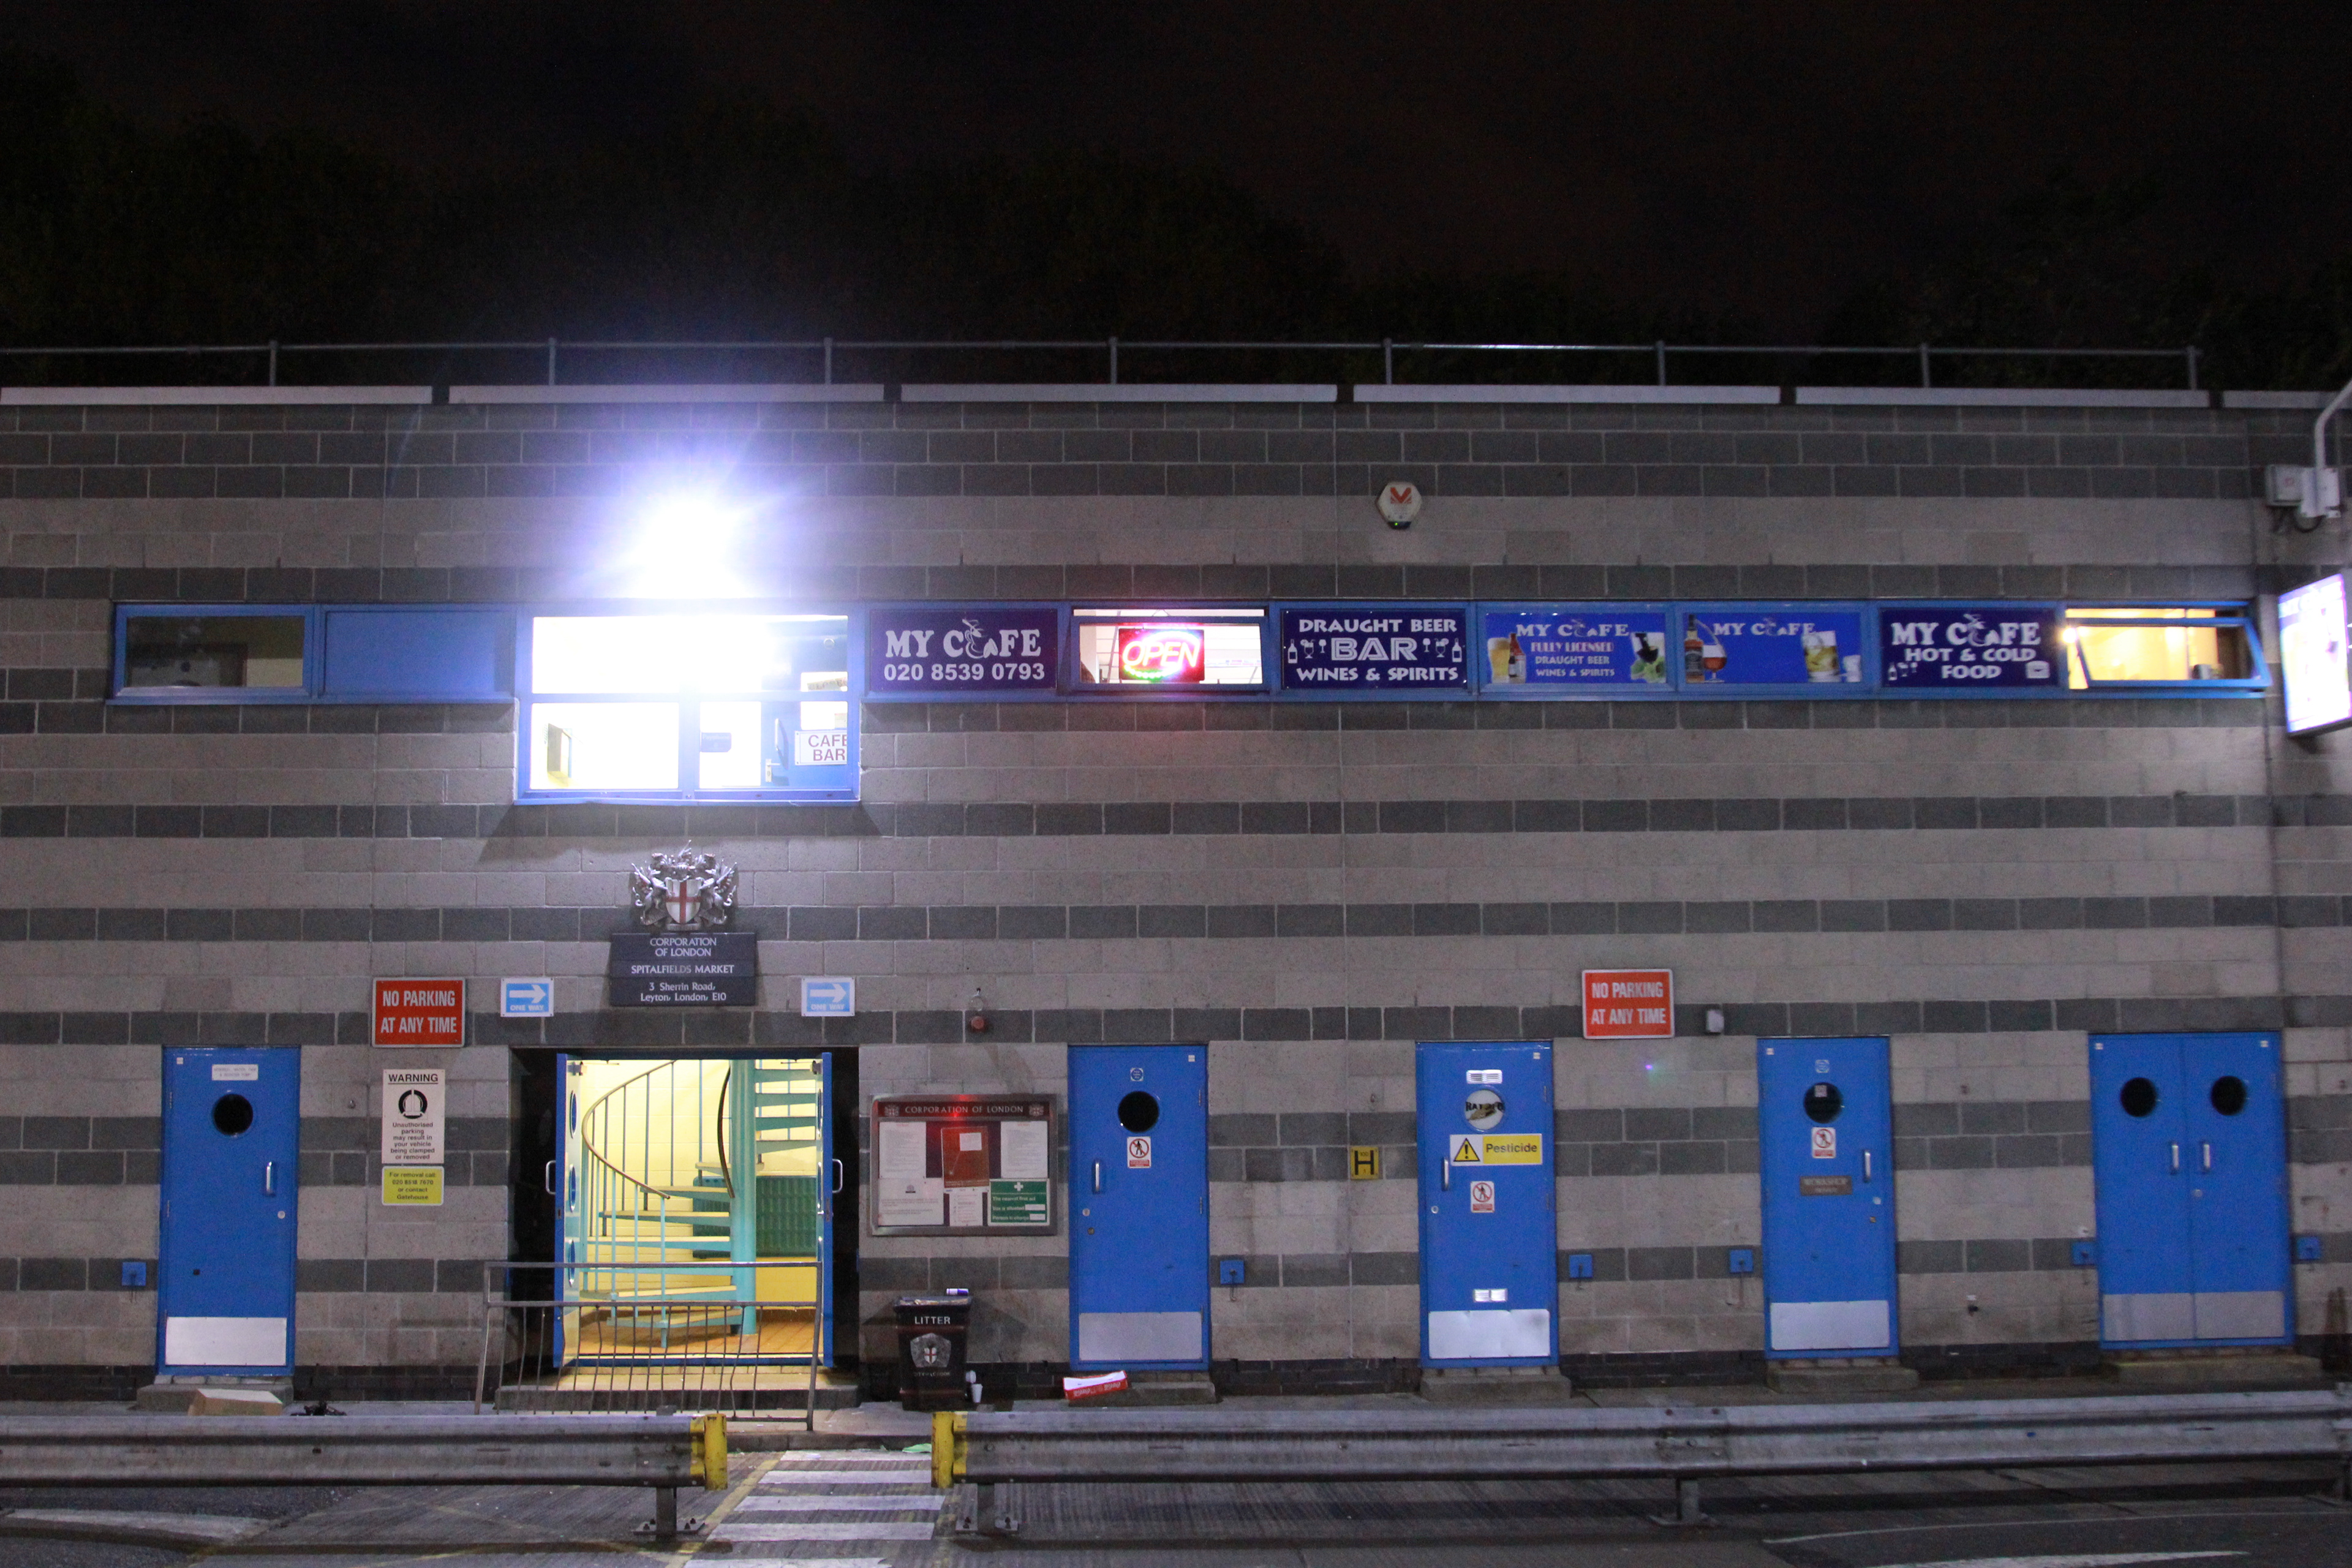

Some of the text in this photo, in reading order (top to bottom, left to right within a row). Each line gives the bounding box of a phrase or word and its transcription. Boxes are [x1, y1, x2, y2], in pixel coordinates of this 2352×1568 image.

[1299, 619, 1457, 633] DRAUGHT BEER
[1516, 624, 1551, 636] MY
[1713, 623, 1746, 635] MY
[1891, 622, 1939, 645] MY
[886, 630, 935, 658] MY
[1331, 638, 1418, 661] BAR
[1531, 642, 1615, 652] FULLY LICENSED
[1122, 640, 1200, 668] OPEN
[1904, 648, 2037, 662] HOT & COLD
[884, 663, 1045, 680] 020 8539 0793
[1296, 667, 1458, 681] WINES & SPIRITS
[1536, 668, 1566, 677] WINES
[1580, 668, 1615, 677] SPIRITS
[1941, 665, 2002, 679] FOOD
[813, 748, 845, 761] BAR
[650, 938, 717, 946] CORPORATION
[631, 965, 734, 974] SPITALFIELDS MARKET
[660, 982, 689, 990] Sherrin
[1592, 982, 1664, 998] NO PARKING
[382, 990, 456, 1006] NO PARKING
[640, 992, 726, 1002] Leyton, London, E10
[1591, 1008, 1666, 1024] AT ANY TIME
[380, 1017, 457, 1033] AT ANY TIME
[388, 1074, 438, 1082] WARNING
[1486, 1143, 1537, 1153] Pesticide
[1354, 1150, 1374, 1175] H
